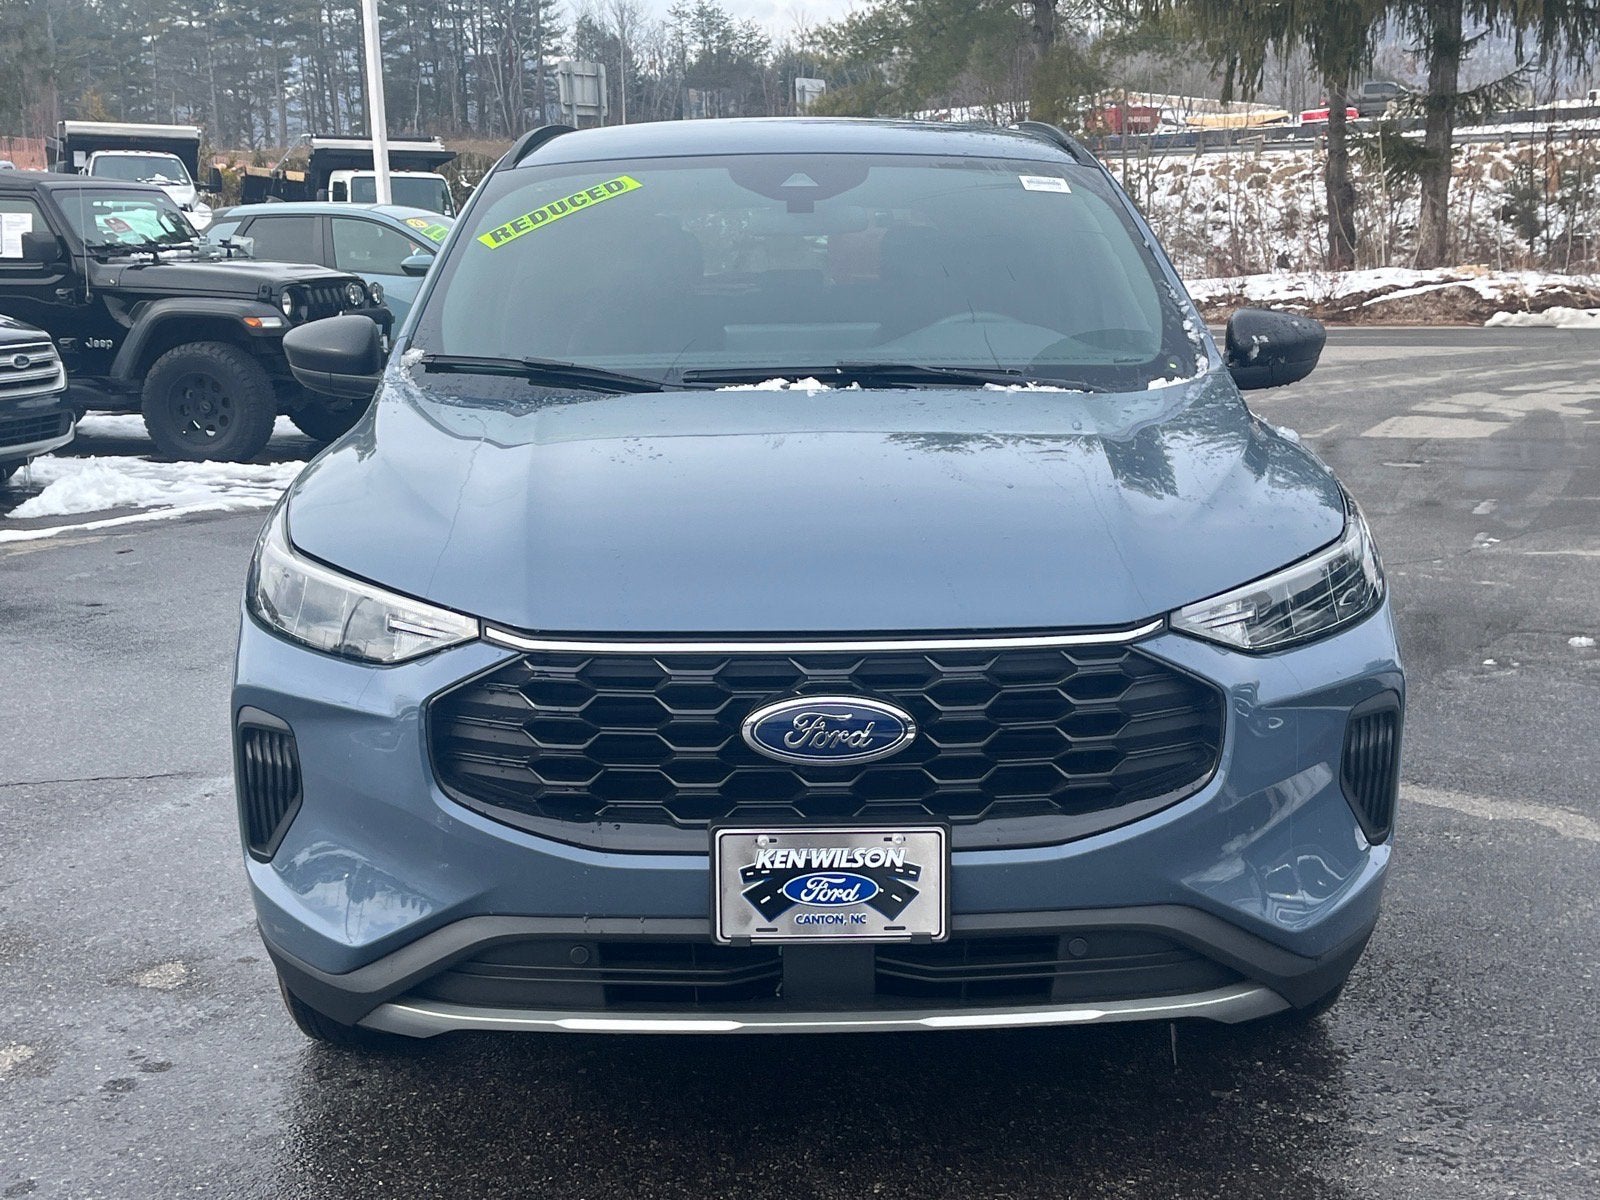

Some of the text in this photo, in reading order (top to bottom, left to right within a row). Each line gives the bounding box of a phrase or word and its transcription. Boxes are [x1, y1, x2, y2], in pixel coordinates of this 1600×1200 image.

[489, 179, 626, 244] REDUCED
[85, 337, 113, 350] Jeep
[784, 712, 875, 749] Ford
[755, 847, 907, 869] KEN WILSON
[800, 876, 861, 902] Ford
[795, 914, 867, 926] CANTON, NC
